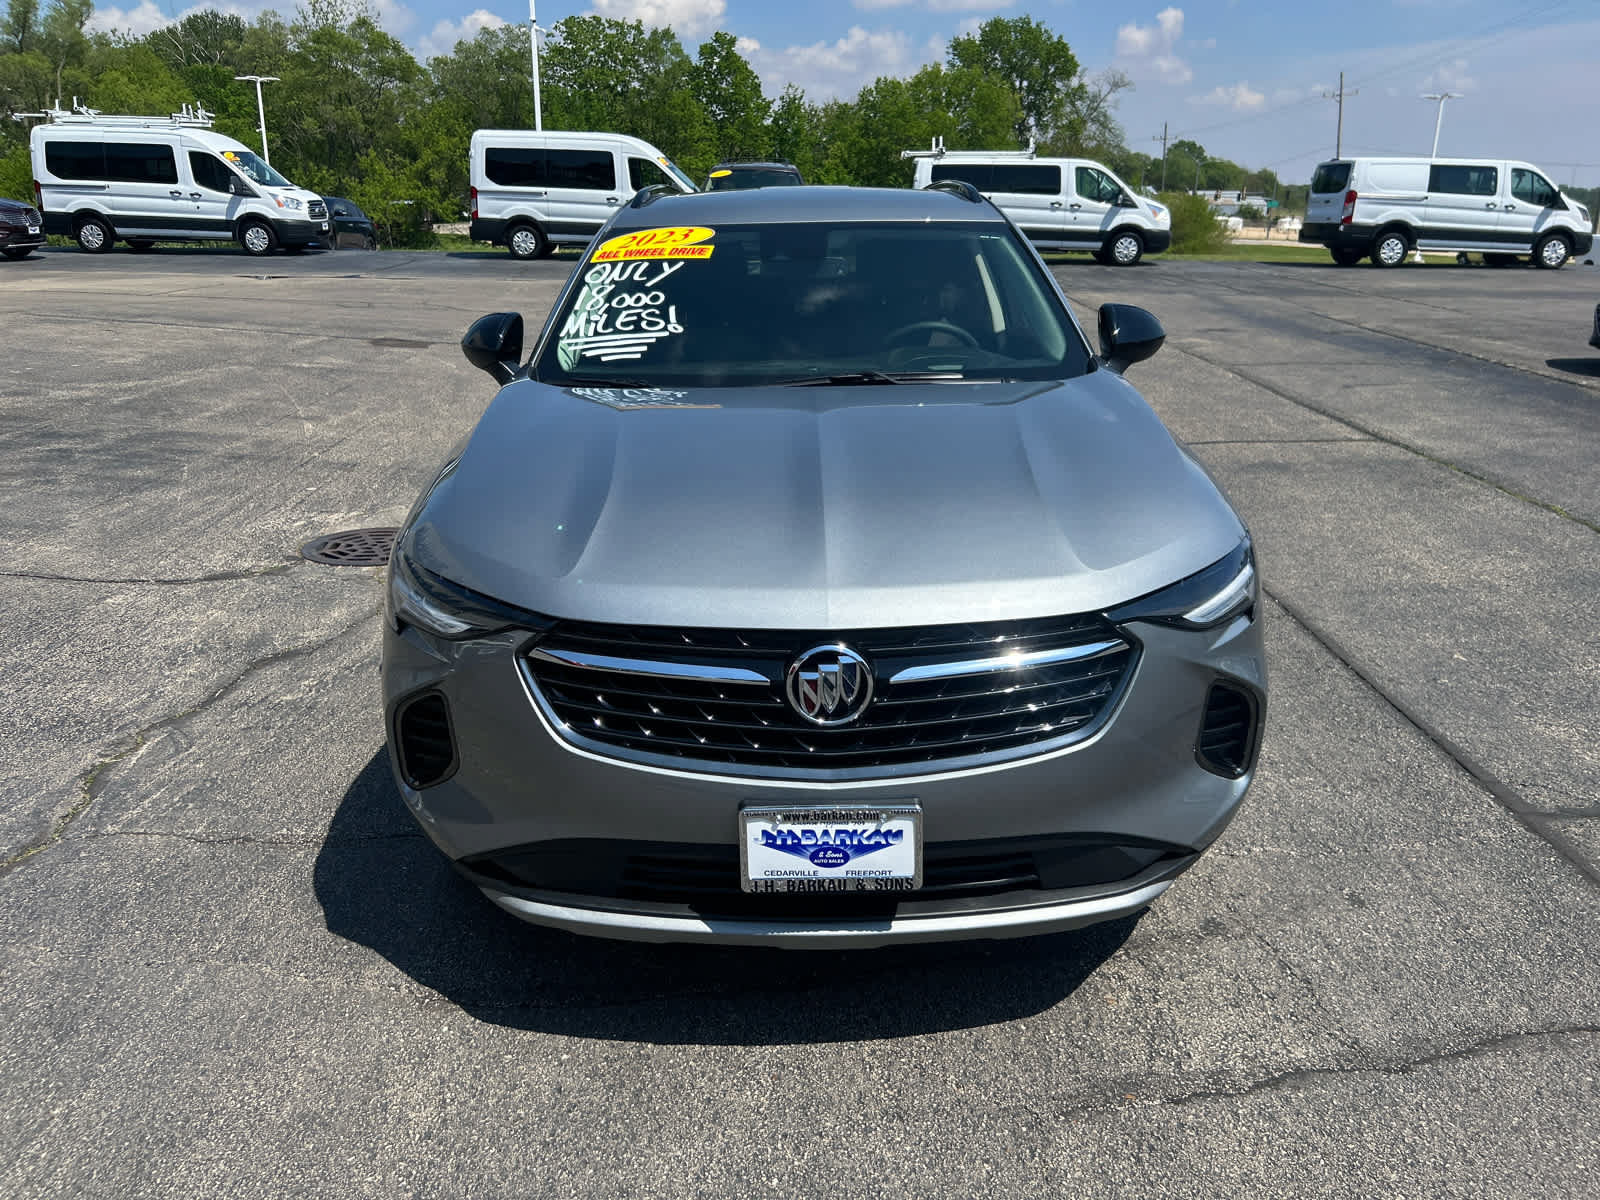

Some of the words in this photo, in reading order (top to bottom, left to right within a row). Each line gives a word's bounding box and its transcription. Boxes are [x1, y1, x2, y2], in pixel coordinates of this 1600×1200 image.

[618, 228, 695, 249] 2023
[595, 250, 621, 260] ALL
[623, 248, 666, 258] WHEEL
[668, 247, 711, 257] DRIVE
[584, 261, 685, 287] ONLY
[783, 810, 880, 822] www.barkau.com
[763, 869, 819, 877] CEDARVILLE
[845, 869, 893, 877] FREEPORT
[750, 878, 780, 893] J.H.
[786, 878, 848, 892] BARKAU
[855, 878, 867, 891] &
[874, 877, 914, 890] SONS
